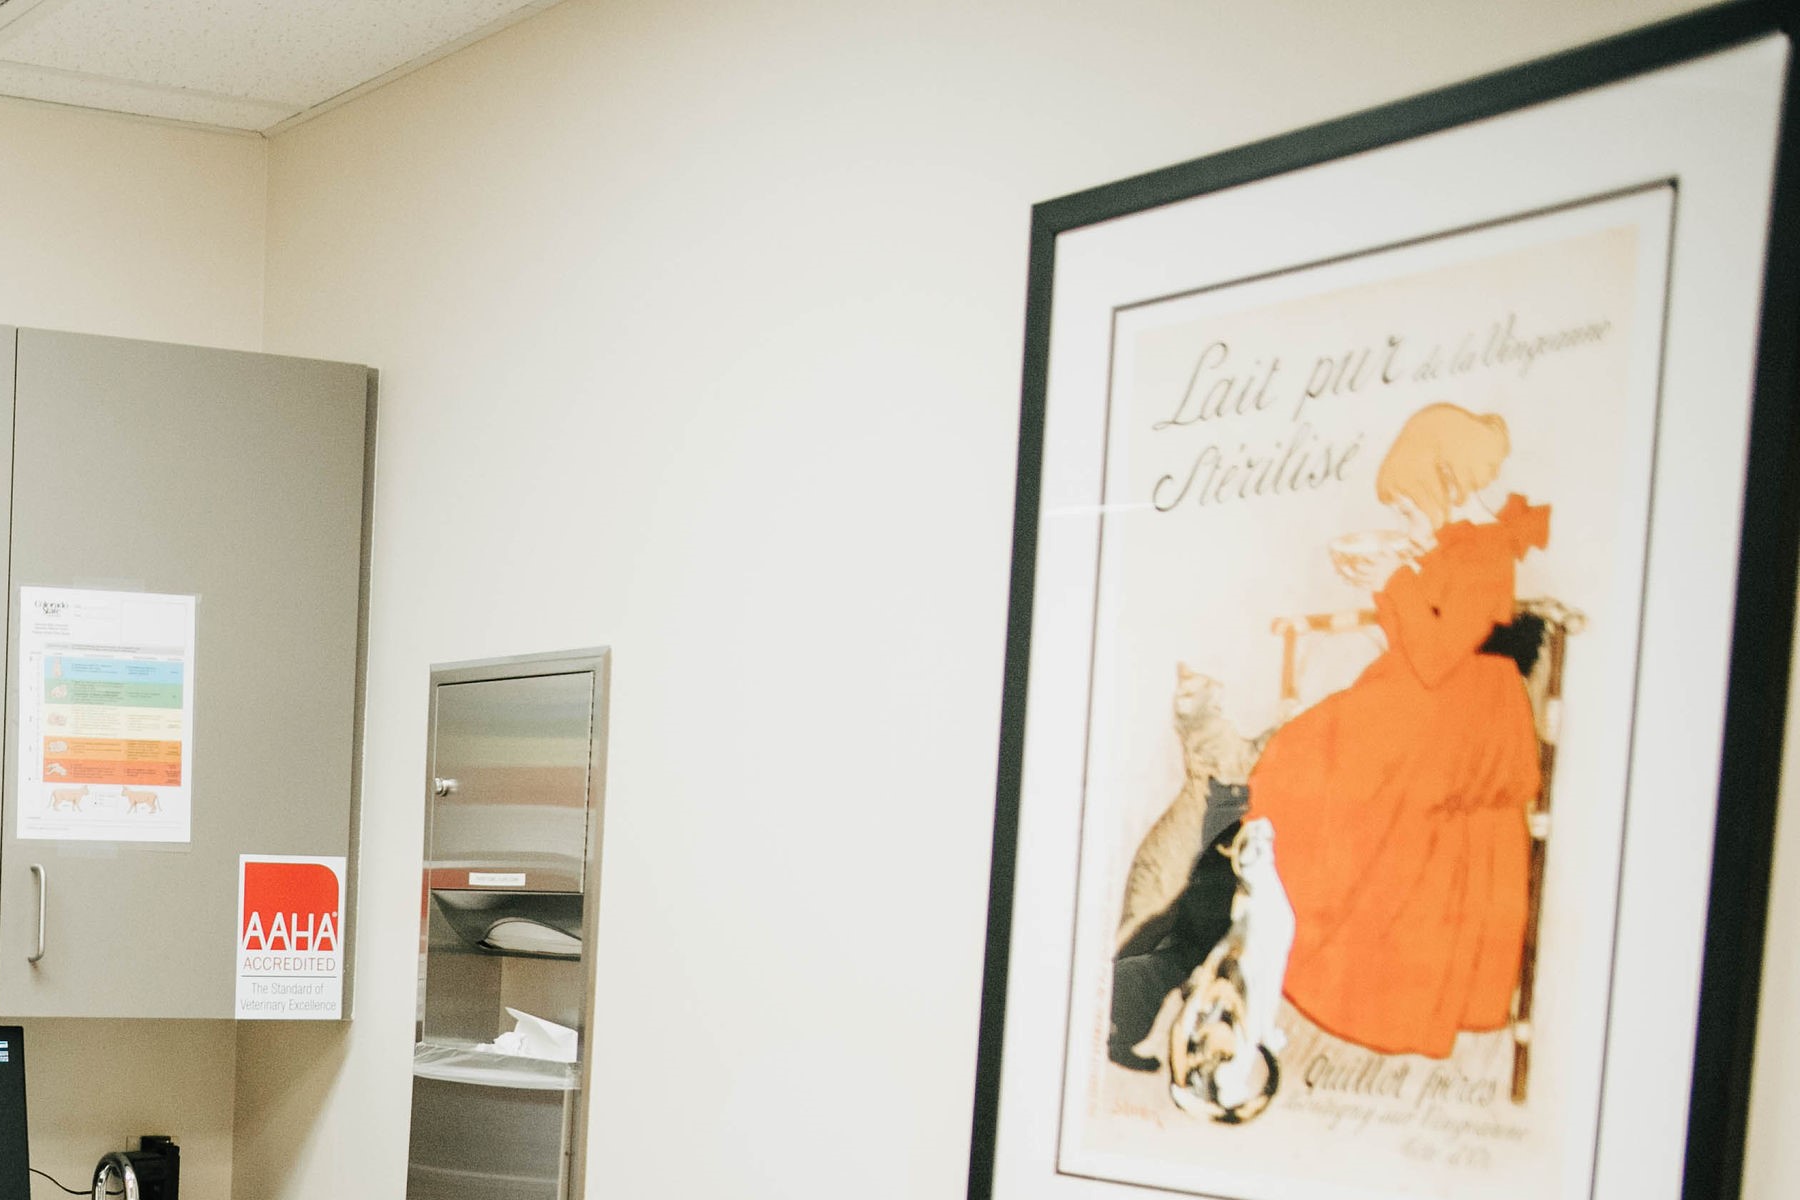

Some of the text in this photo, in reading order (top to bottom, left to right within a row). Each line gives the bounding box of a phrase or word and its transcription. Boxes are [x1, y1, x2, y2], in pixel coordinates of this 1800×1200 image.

[1152, 340, 1280, 431] Lait
[1292, 334, 1404, 421] pur
[1153, 424, 1365, 512] Stérilisé
[242, 911, 338, 951] AAHA
[243, 956, 336, 972] ACCREDITED
[252, 982, 324, 995] The Standard of
[240, 999, 337, 1013] Veterinary Excellence
